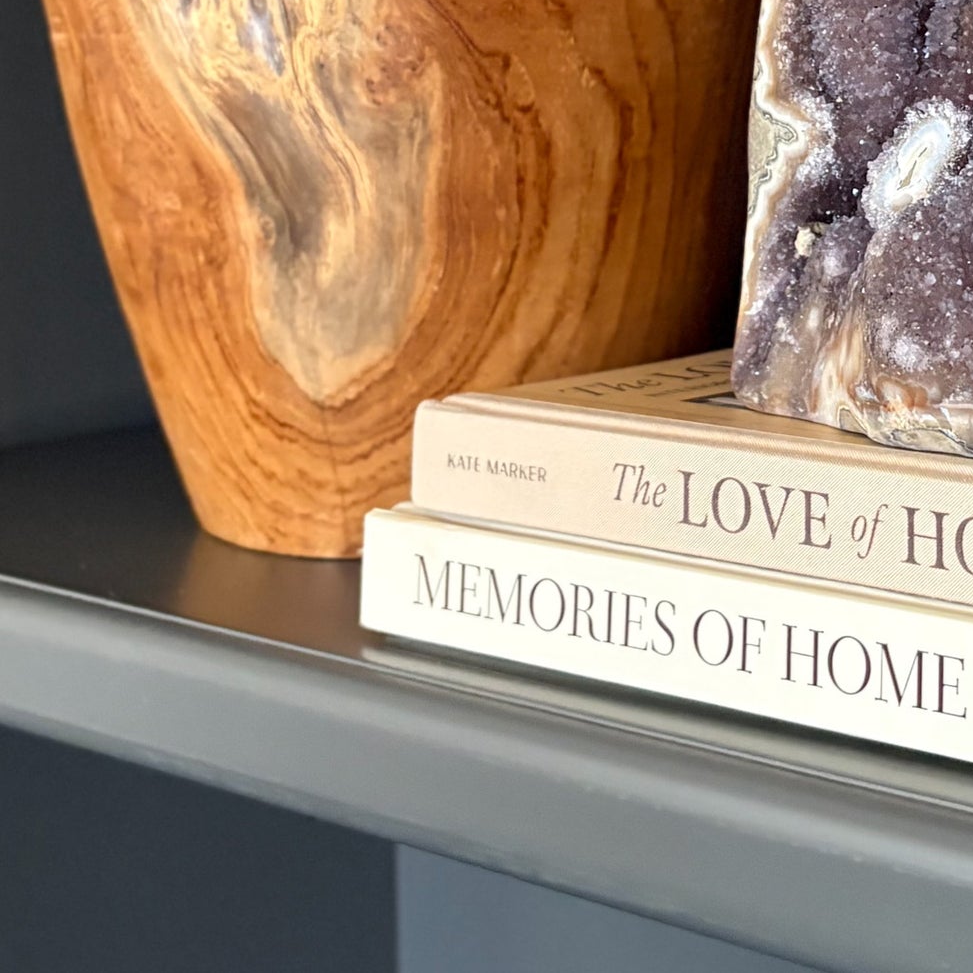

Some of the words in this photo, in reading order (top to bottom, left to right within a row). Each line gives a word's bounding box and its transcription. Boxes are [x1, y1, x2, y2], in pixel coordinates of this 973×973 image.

[560, 379, 662, 396] The
[447, 453, 481, 473] KATE
[486, 459, 547, 483] MARKER
[613, 462, 668, 509] The
[677, 469, 833, 551] LOVE
[850, 503, 889, 560] of
[413, 553, 677, 658] MEMORIES
[693, 608, 767, 675] OF
[781, 623, 969, 721] HOME
